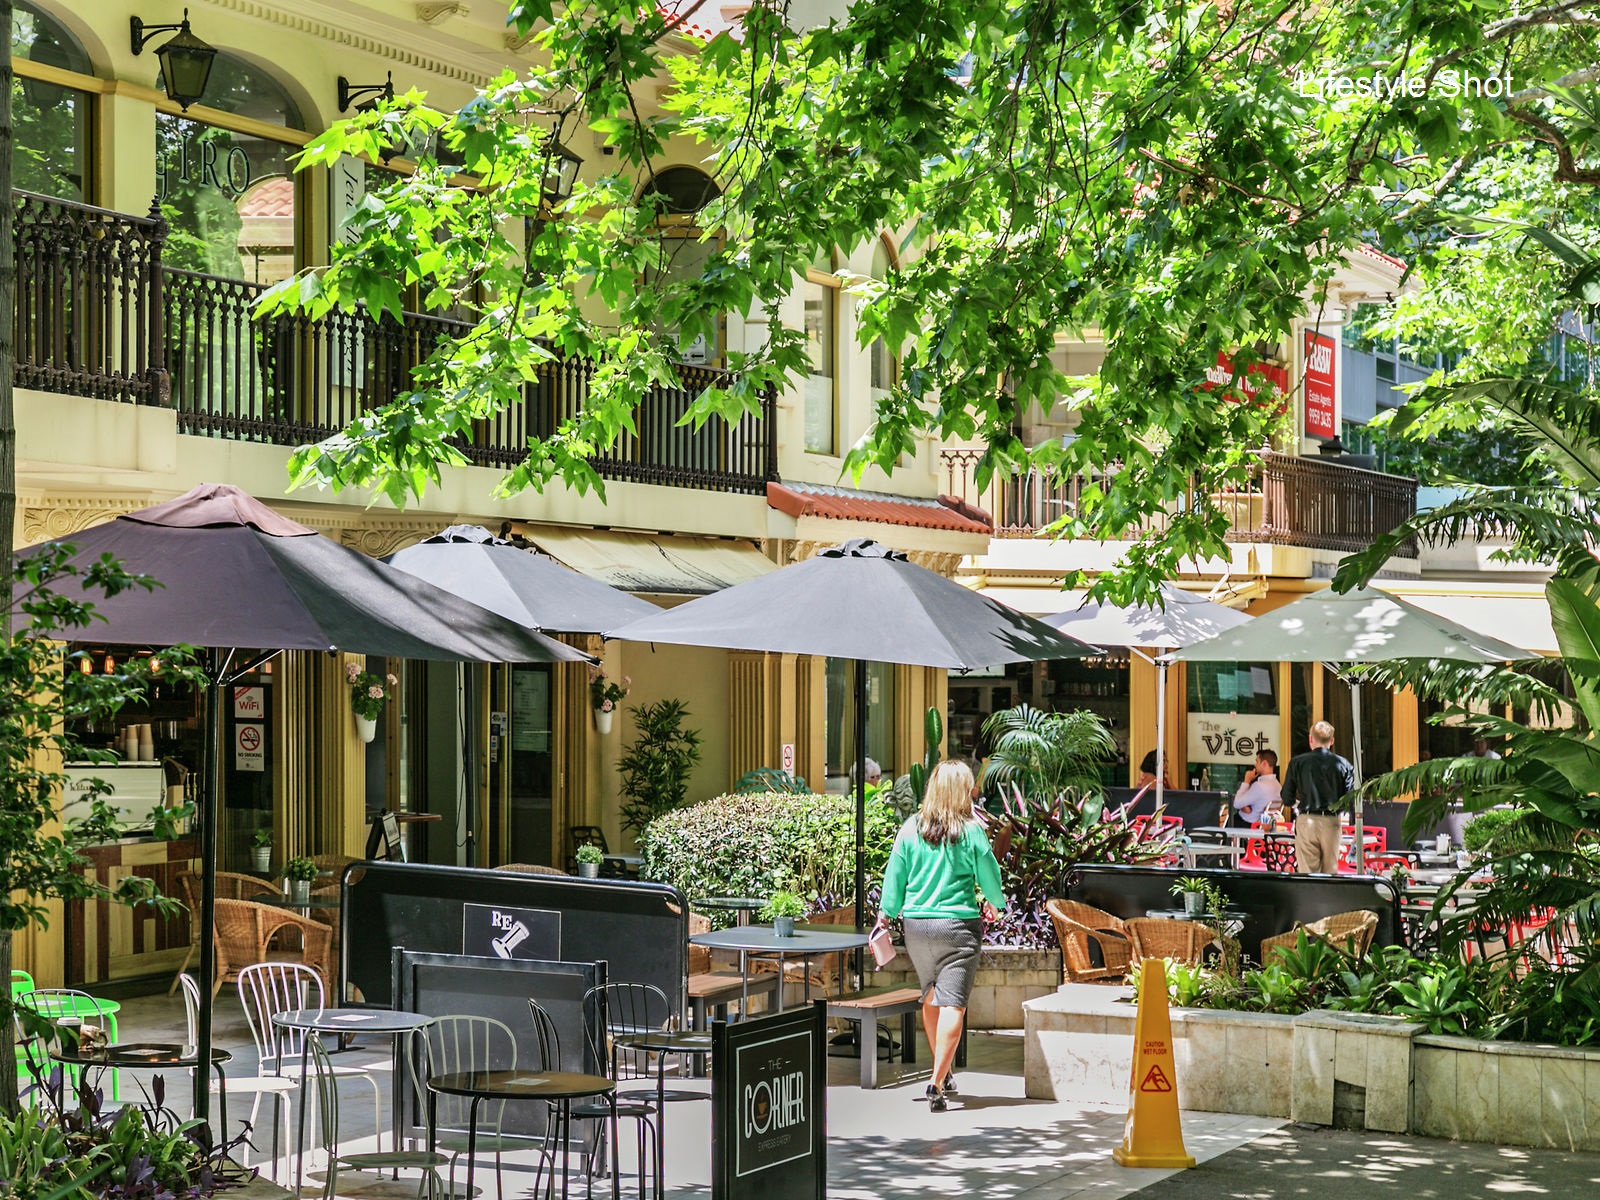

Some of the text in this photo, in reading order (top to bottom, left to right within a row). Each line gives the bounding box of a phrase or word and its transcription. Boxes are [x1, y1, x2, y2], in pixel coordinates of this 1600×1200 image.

[1308, 389, 1332, 408] Estate Agents
[238, 701, 260, 711] WiFi
[1198, 720, 1221, 732] The
[491, 910, 513, 931] RE
[1153, 1048, 1168, 1056] FLOOR
[768, 1058, 782, 1071] THE
[744, 1071, 806, 1139] CORNER
